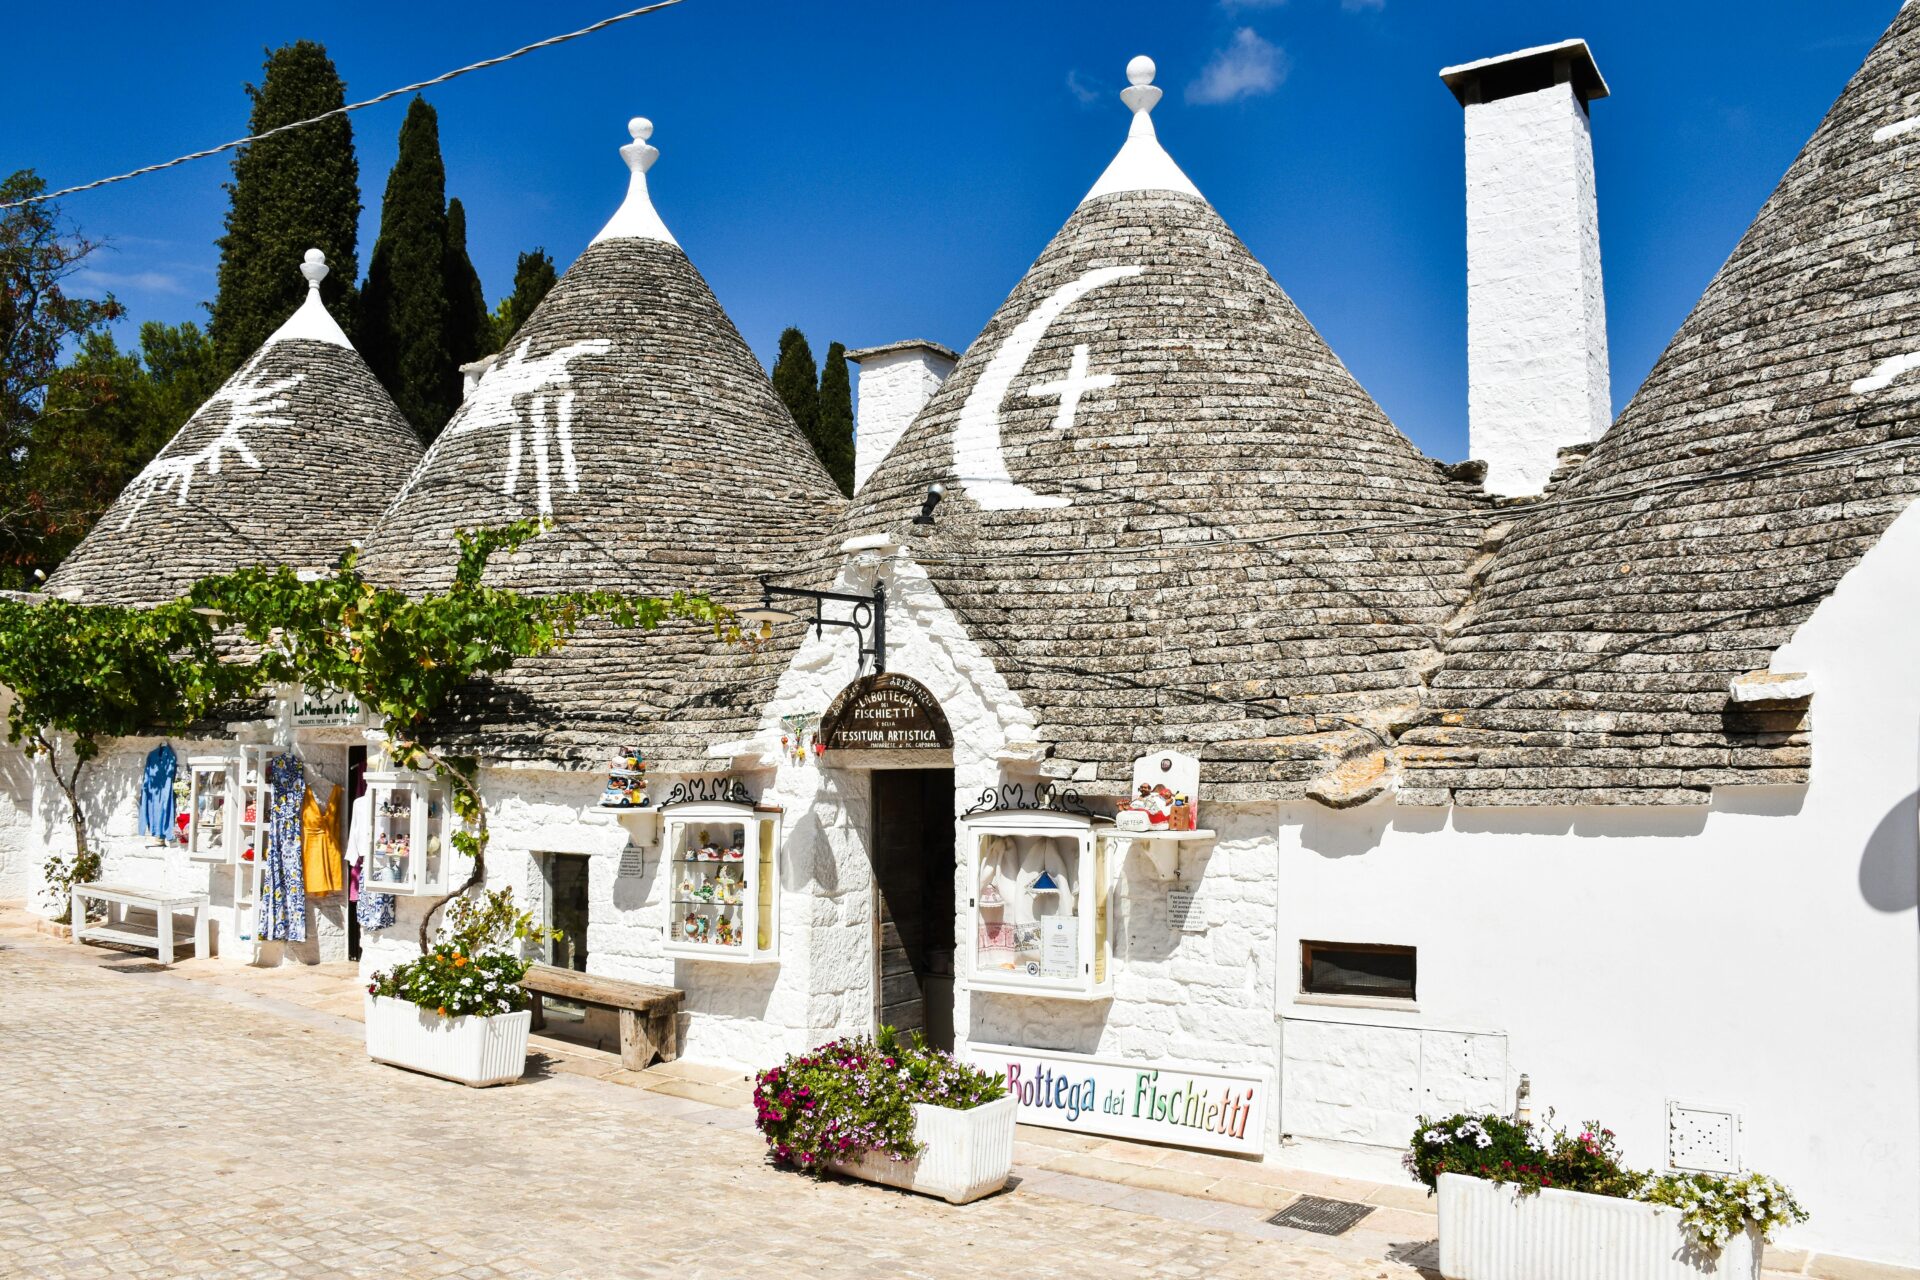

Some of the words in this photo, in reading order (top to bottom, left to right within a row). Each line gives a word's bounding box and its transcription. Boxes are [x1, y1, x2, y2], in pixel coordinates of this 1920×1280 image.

[334, 703, 340, 715] di
[341, 699, 360, 718] Puglia
[854, 707, 915, 719] FISCHIETTI
[835, 730, 884, 741] TESSITURA
[887, 729, 936, 741] ARTISTICA
[1006, 1060, 1096, 1122] Bottega
[1103, 1088, 1125, 1116] dei
[1131, 1068, 1254, 1140] Fischietti
